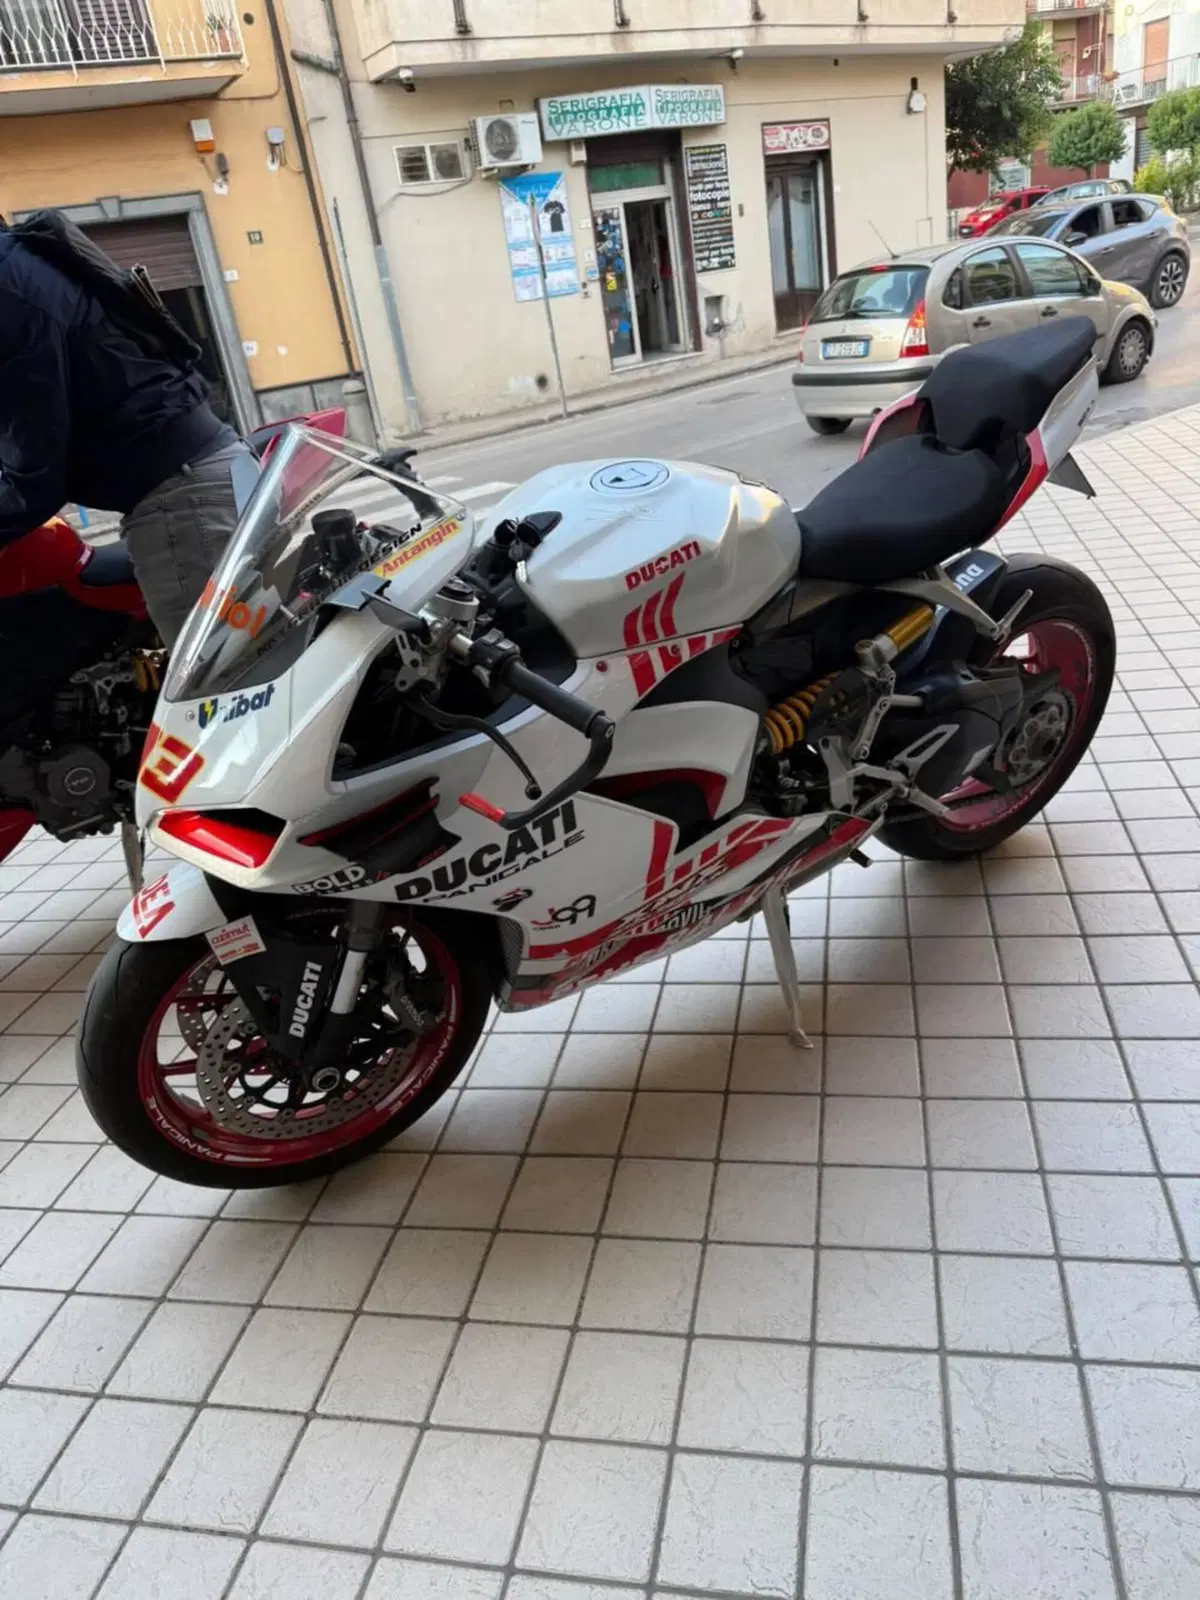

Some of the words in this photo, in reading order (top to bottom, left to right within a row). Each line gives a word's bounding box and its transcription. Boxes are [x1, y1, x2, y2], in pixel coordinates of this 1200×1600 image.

[548, 92, 645, 114] SERIGRAFIA
[655, 89, 721, 101] SERIGRAFIA
[550, 106, 646, 126] TIPOGRAFIA
[656, 102, 722, 113] TIPOGRAFIA
[656, 111, 722, 125] VARONE
[551, 117, 646, 137] VARONE
[624, 540, 702, 591] DUCATI
[394, 800, 577, 901] DUCATI
[291, 864, 367, 895] BOLD
[289, 961, 322, 1038] DUCATI
